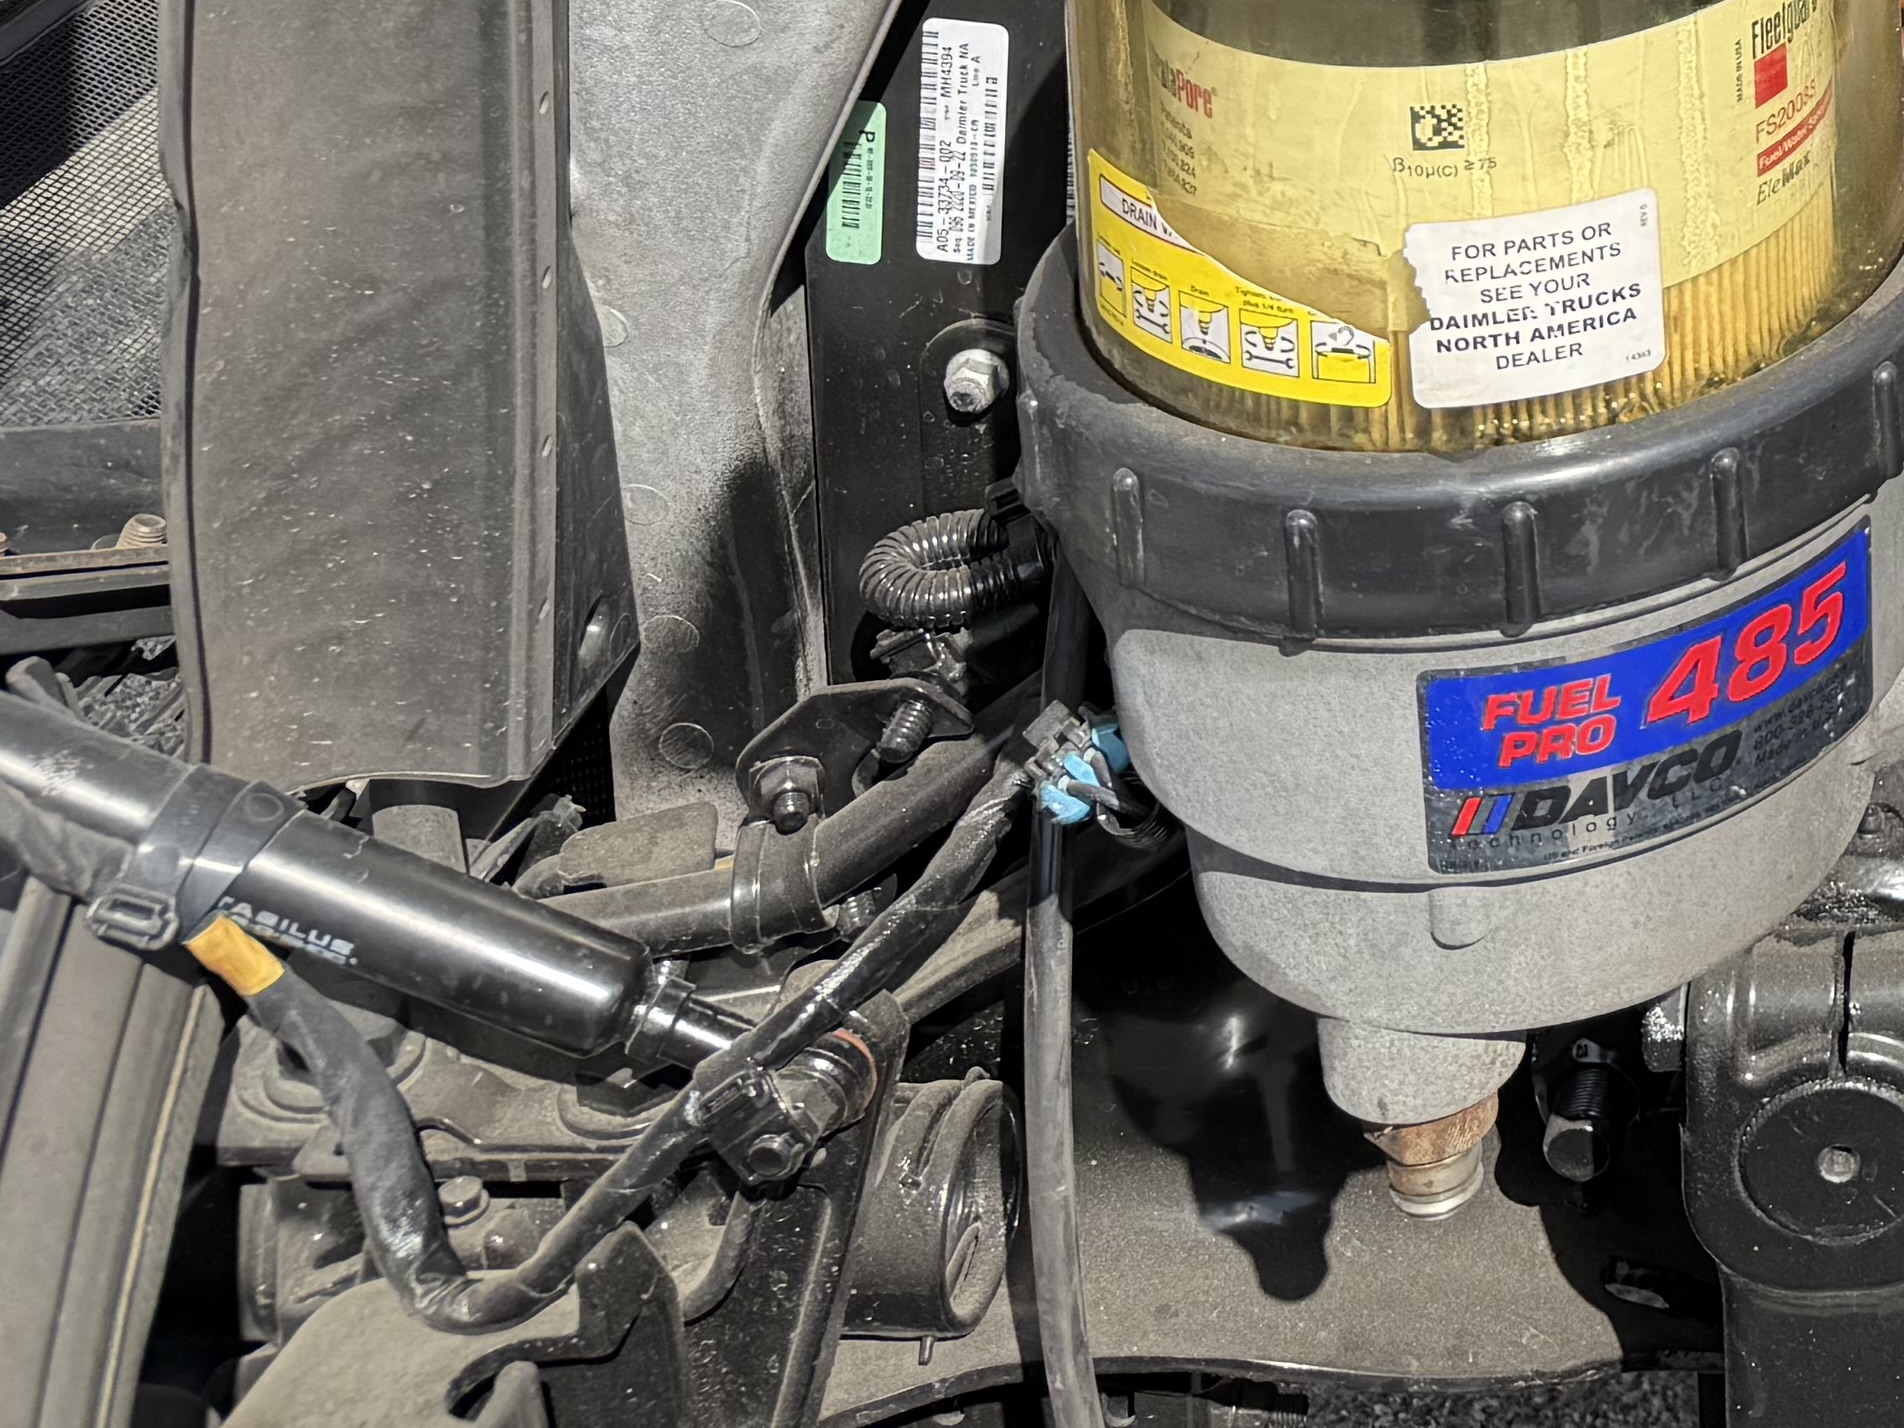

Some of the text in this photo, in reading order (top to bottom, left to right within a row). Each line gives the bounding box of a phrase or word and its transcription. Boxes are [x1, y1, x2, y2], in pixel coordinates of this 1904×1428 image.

[956, 43, 969, 145] Daimler Truck NA
[1122, 197, 1158, 232] DRAIN
[1444, 242, 1622, 285] REPLACEMENTS
[1451, 222, 1613, 261] FOR PARTS OR
[1429, 282, 1643, 332] DAIMLER TRUCKS
[1480, 272, 1591, 304] SEE YOUR
[1436, 307, 1638, 354] NORTH AMERICA
[1495, 342, 1584, 371] DEALER
[1480, 673, 1623, 732] FUEL
[1644, 559, 1848, 726] 485
[1498, 713, 1618, 769] PRO
[1510, 728, 1744, 832] DAVCO
